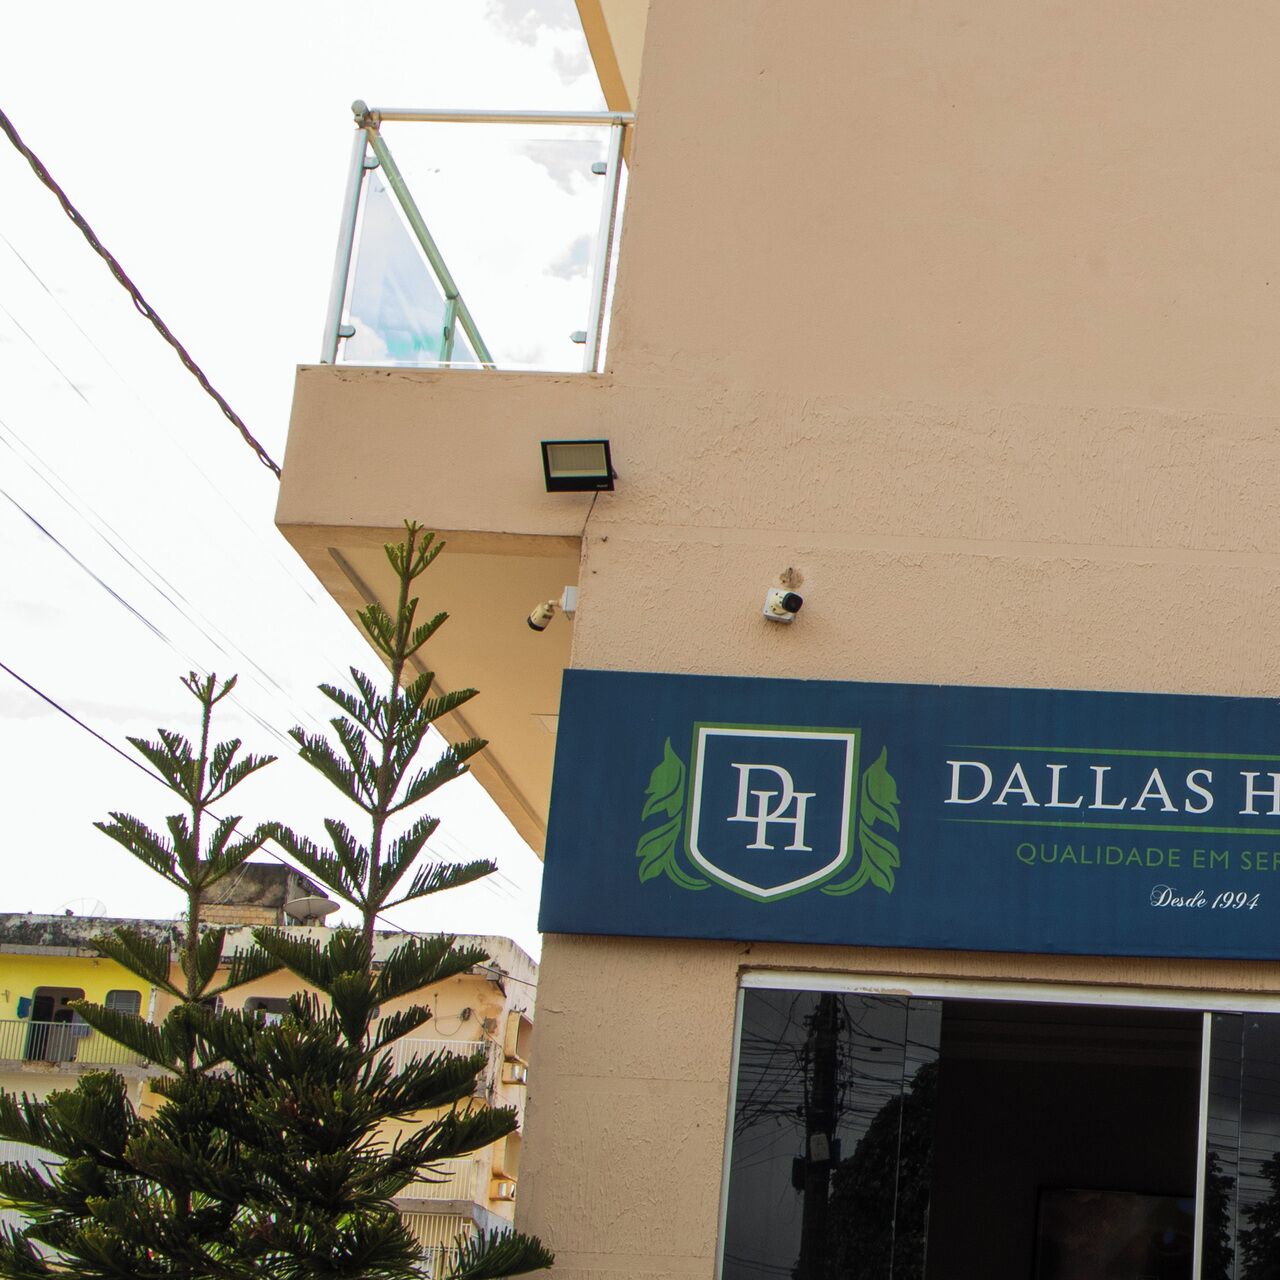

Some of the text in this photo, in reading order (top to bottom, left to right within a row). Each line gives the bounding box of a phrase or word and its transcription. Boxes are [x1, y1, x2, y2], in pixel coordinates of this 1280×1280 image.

[944, 760, 1215, 814] DALLAS
[1016, 842, 1181, 869] QUALIDADE
[1192, 848, 1230, 870] EM
[1149, 883, 1261, 910] Desde 1994
